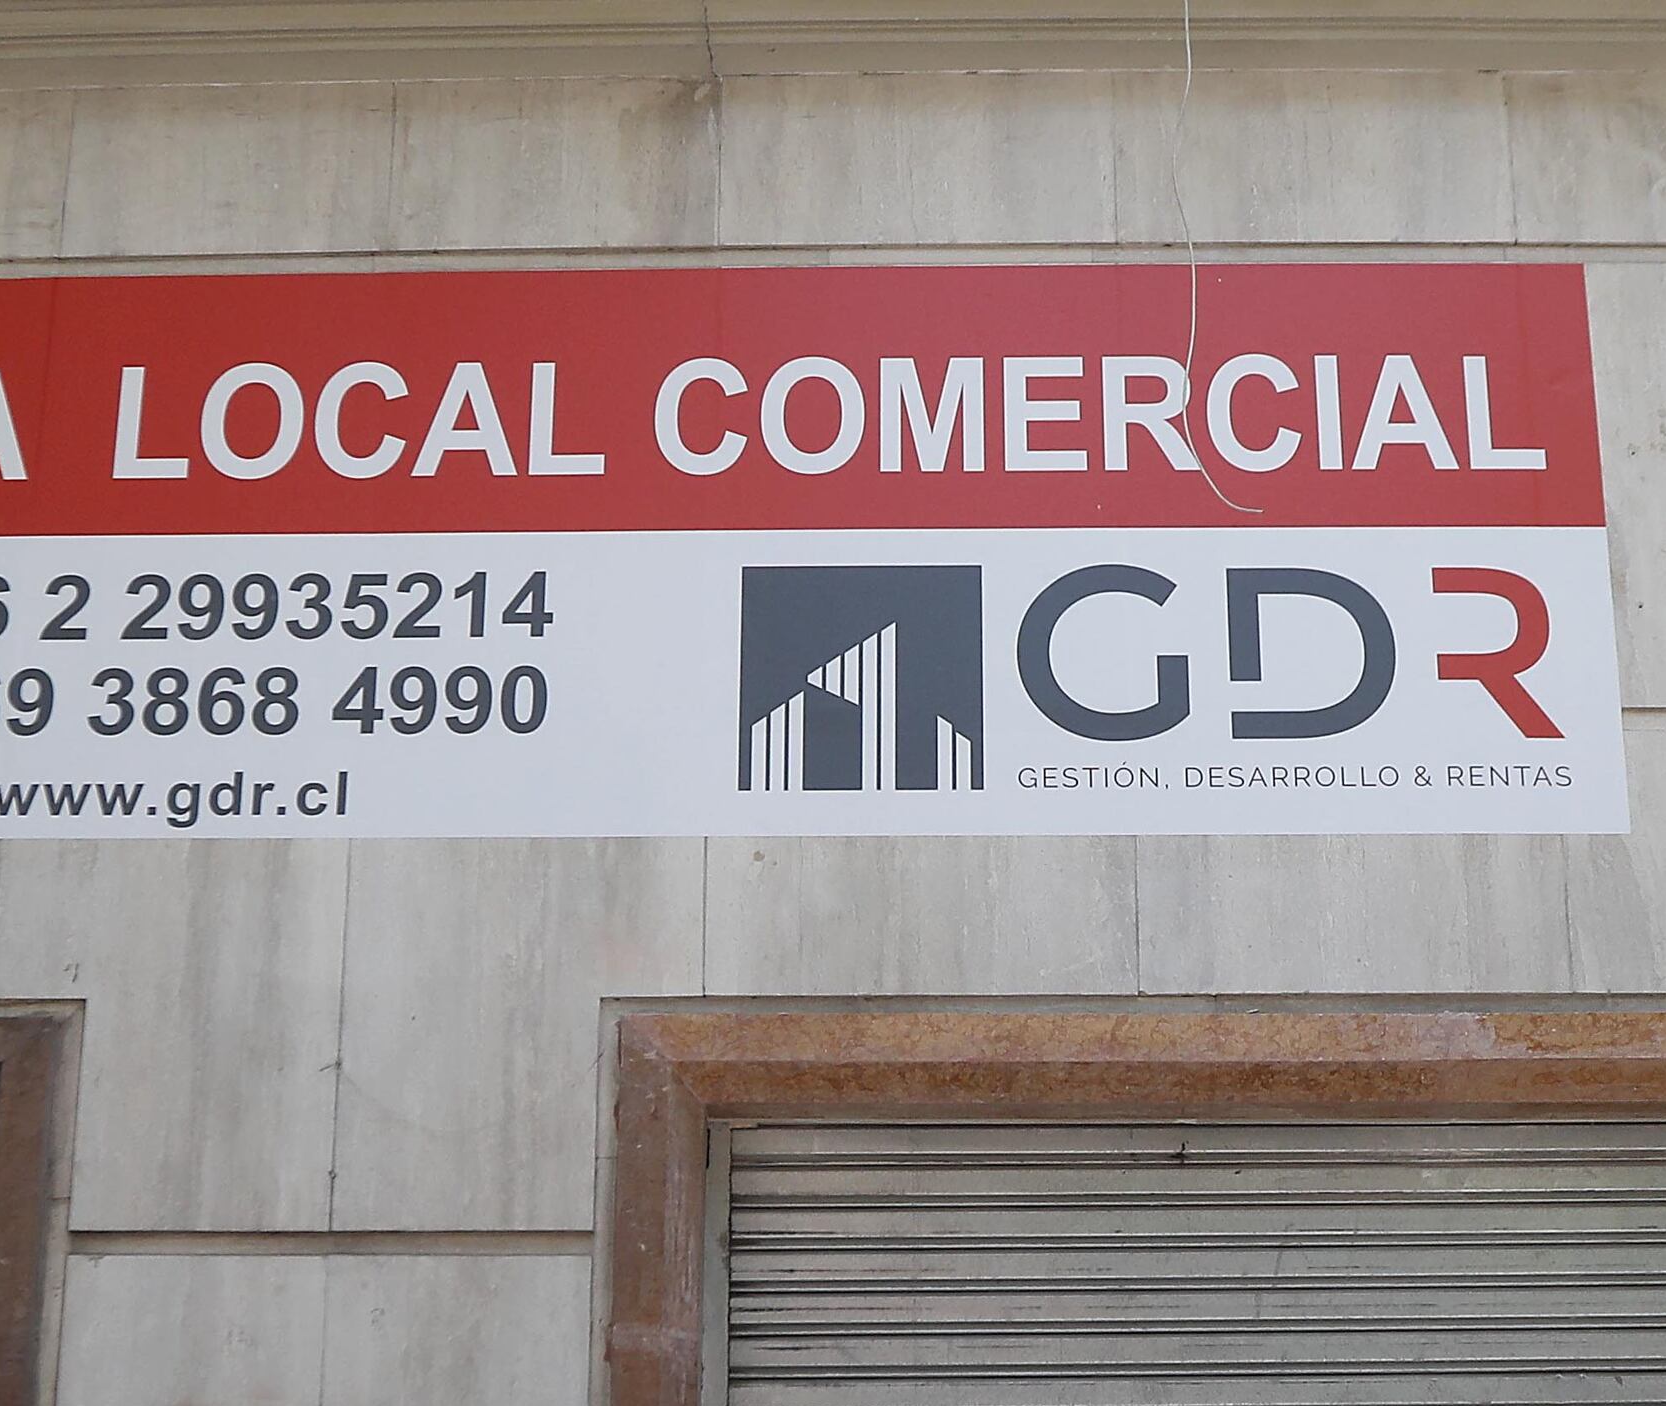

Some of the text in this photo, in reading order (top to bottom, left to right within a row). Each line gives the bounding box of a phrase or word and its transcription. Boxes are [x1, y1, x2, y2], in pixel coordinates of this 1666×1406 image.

[113, 361, 605, 479] LOCAL
[653, 352, 1547, 476] COMERCIAL
[40, 575, 90, 640] 2
[121, 571, 553, 641] 29935214
[1017, 565, 1565, 741] GDR
[88, 667, 298, 736] 3868
[332, 665, 547, 735] 4990
[1017, 761, 1572, 790] GESTIÓN, DESARROLLO & RENTAS
